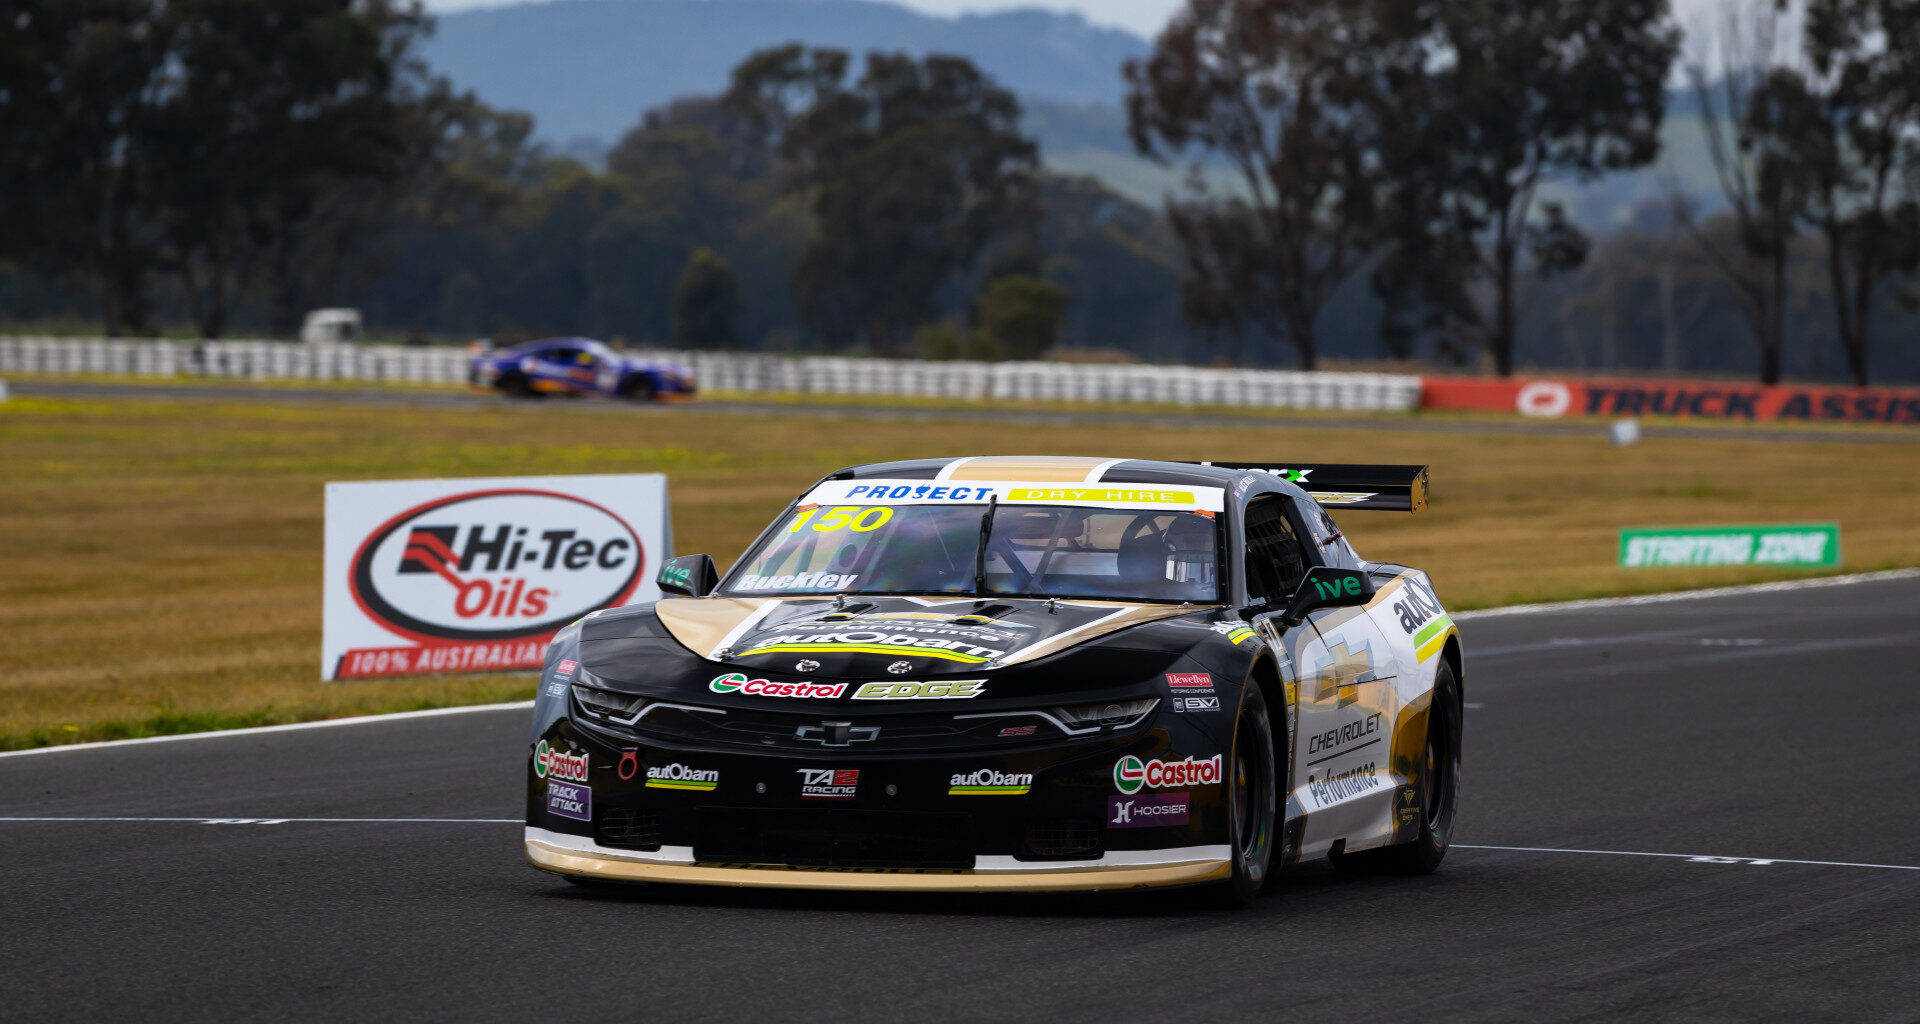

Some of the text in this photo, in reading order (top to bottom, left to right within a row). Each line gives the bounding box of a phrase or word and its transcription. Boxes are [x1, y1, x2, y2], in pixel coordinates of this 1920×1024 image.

[1586, 388, 1762, 417] TRUCK
[1027, 489, 1086, 500] DRY
[1106, 490, 1175, 502] HIRE
[789, 506, 893, 533] 150
[458, 525, 630, 571] Hi-Tec
[1625, 532, 1828, 566] STARTING ZONE
[661, 559, 691, 587] ive
[733, 571, 858, 590] Buckley
[455, 579, 550, 619] Oils
[1309, 576, 1362, 600] ive
[351, 650, 409, 674] 100%
[744, 679, 845, 698] Castrol
[856, 680, 985, 698] EDGE
[1168, 674, 1210, 686] Llewellyn
[1001, 726, 1037, 737] SS
[1308, 712, 1382, 755] CHEVROLET
[548, 749, 589, 781] Castrol
[796, 768, 860, 786] TA2
[1146, 756, 1221, 786] Castrol
[549, 783, 579, 800] TRACK
[802, 786, 856, 794] RACING
[1308, 761, 1379, 808] Performance
[550, 797, 584, 814] ATTACK
[1134, 804, 1187, 816] HOOSIER
